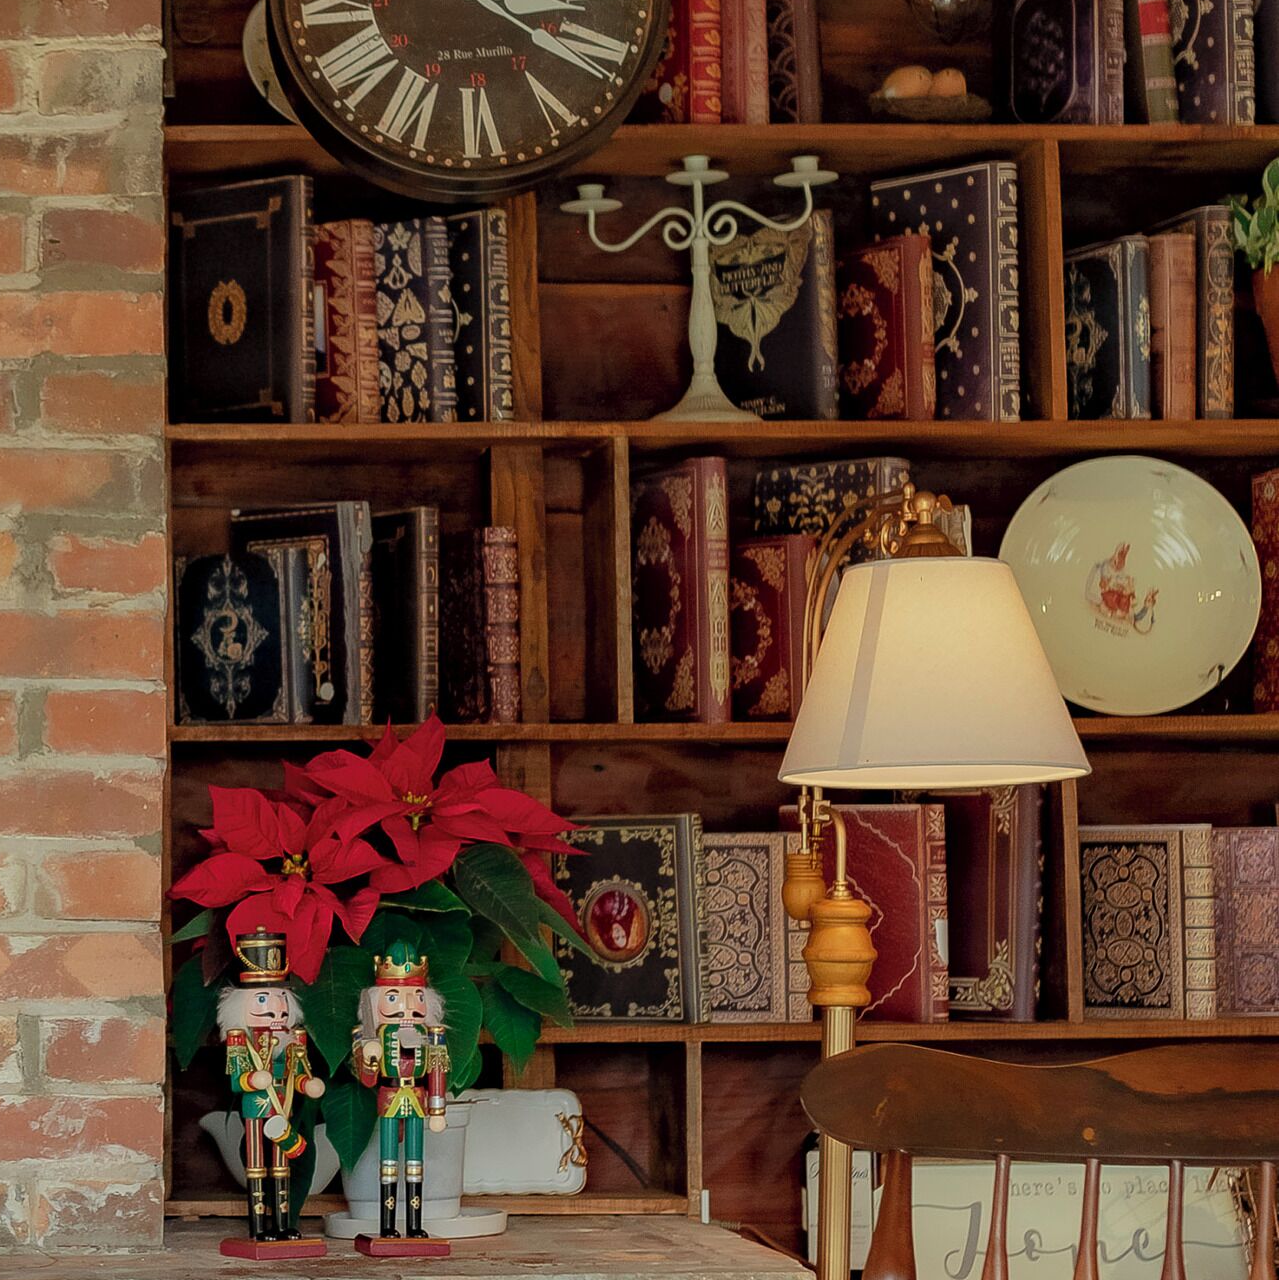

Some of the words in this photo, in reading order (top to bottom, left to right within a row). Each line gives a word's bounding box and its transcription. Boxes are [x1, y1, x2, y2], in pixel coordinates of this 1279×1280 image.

[391, 33, 409, 48] 20
[436, 50, 451, 62] 28
[453, 48, 473, 60] Rue
[475, 45, 514, 58] Murillo
[315, 23, 400, 112] VIII
[424, 62, 441, 78] 19
[511, 55, 528, 72] 17
[469, 71, 487, 88] 18
[374, 65, 440, 152] VII
[524, 69, 580, 138] V
[459, 87, 506, 159] VI
[759, 261, 784, 277] AND
[1010, 1176, 1078, 1197] here's
[1124, 1175, 1169, 1199] plac
